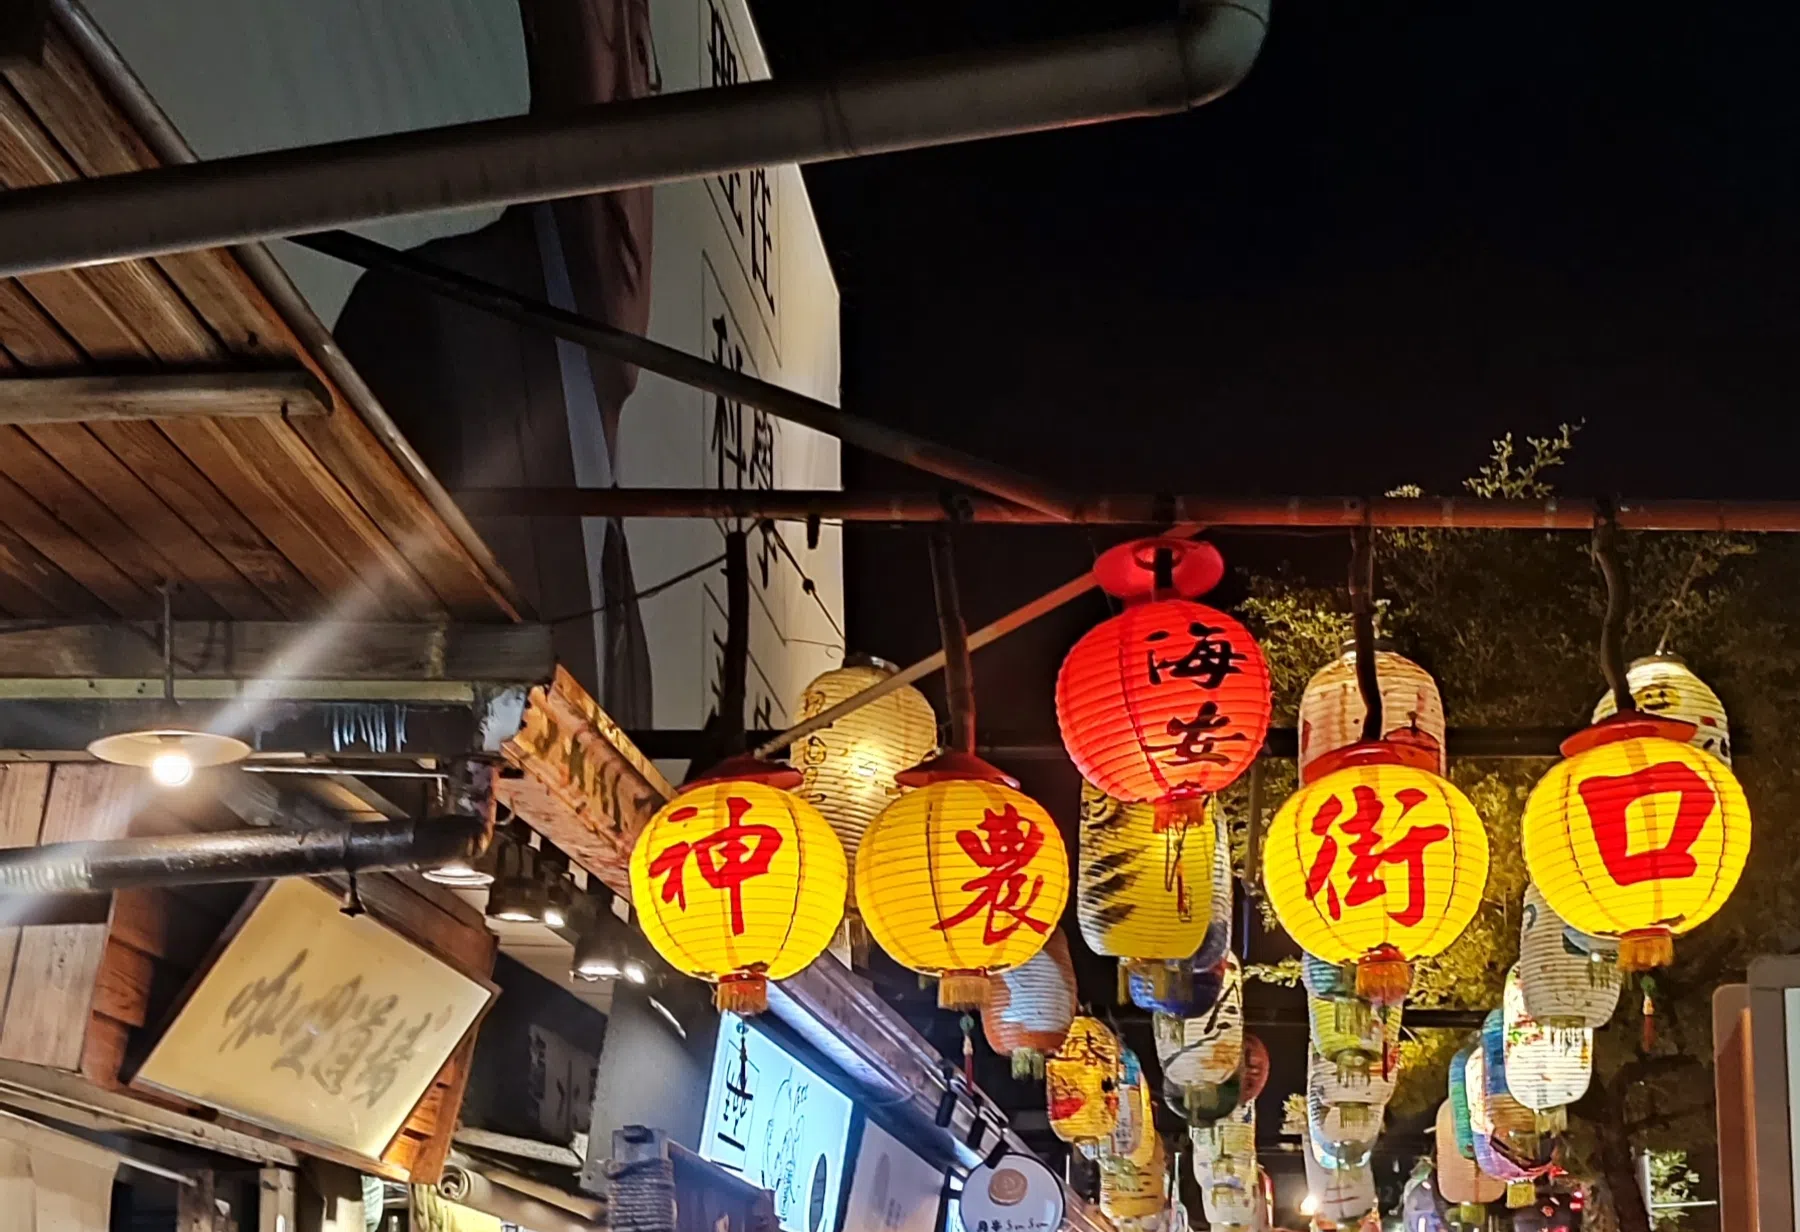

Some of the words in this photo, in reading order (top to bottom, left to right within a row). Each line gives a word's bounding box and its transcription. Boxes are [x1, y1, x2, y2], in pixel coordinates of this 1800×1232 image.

[1144, 622, 1248, 767] 海安
[649, 796, 783, 936] 神
[931, 802, 1053, 946] 農
[1305, 784, 1450, 928] 街
[1578, 761, 1719, 886] 口
